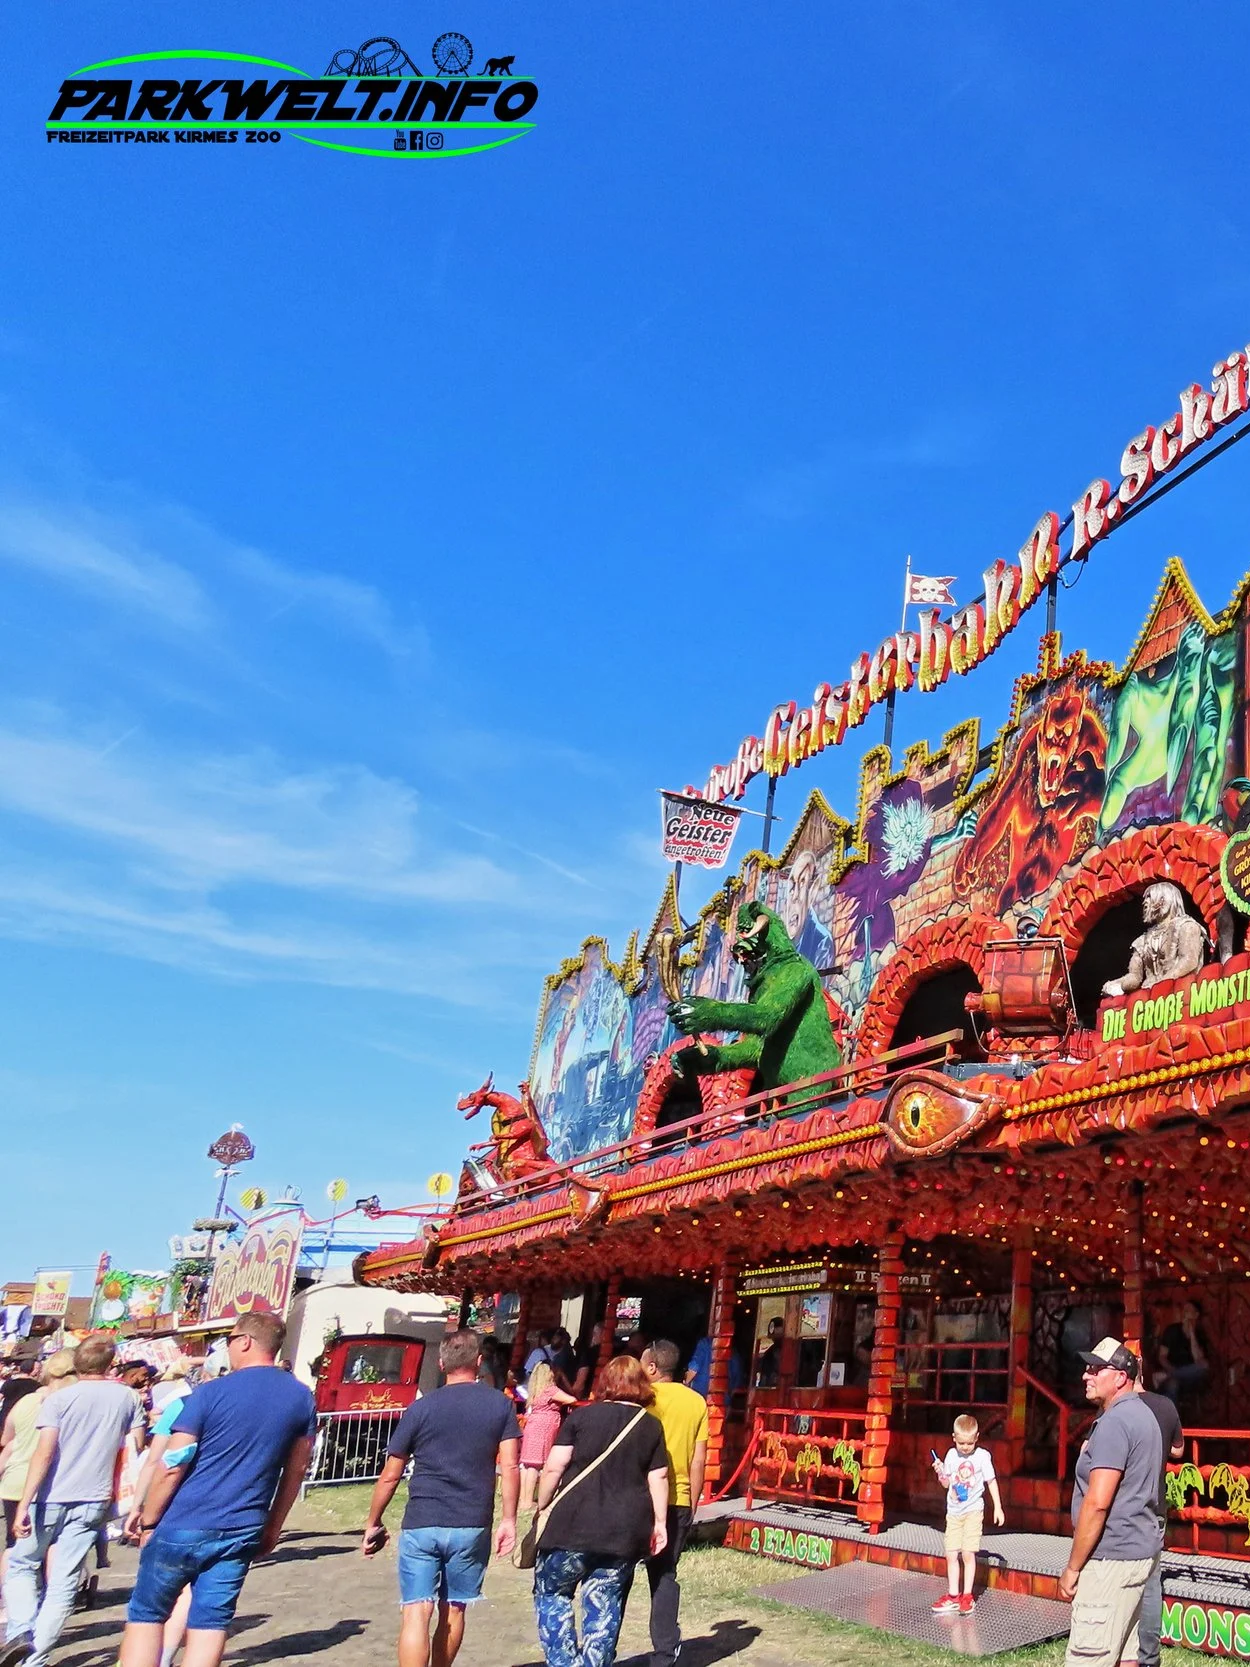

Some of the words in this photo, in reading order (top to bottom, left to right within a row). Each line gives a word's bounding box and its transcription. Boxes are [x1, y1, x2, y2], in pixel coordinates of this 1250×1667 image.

[763, 511, 1059, 778] Geisterbahn
[666, 818, 733, 845] Geister
[689, 804, 735, 826] Neue
[1102, 1008, 1127, 1042] DIE
[750, 1527, 760, 1553] 2
[763, 1526, 833, 1567] ETAGEN
